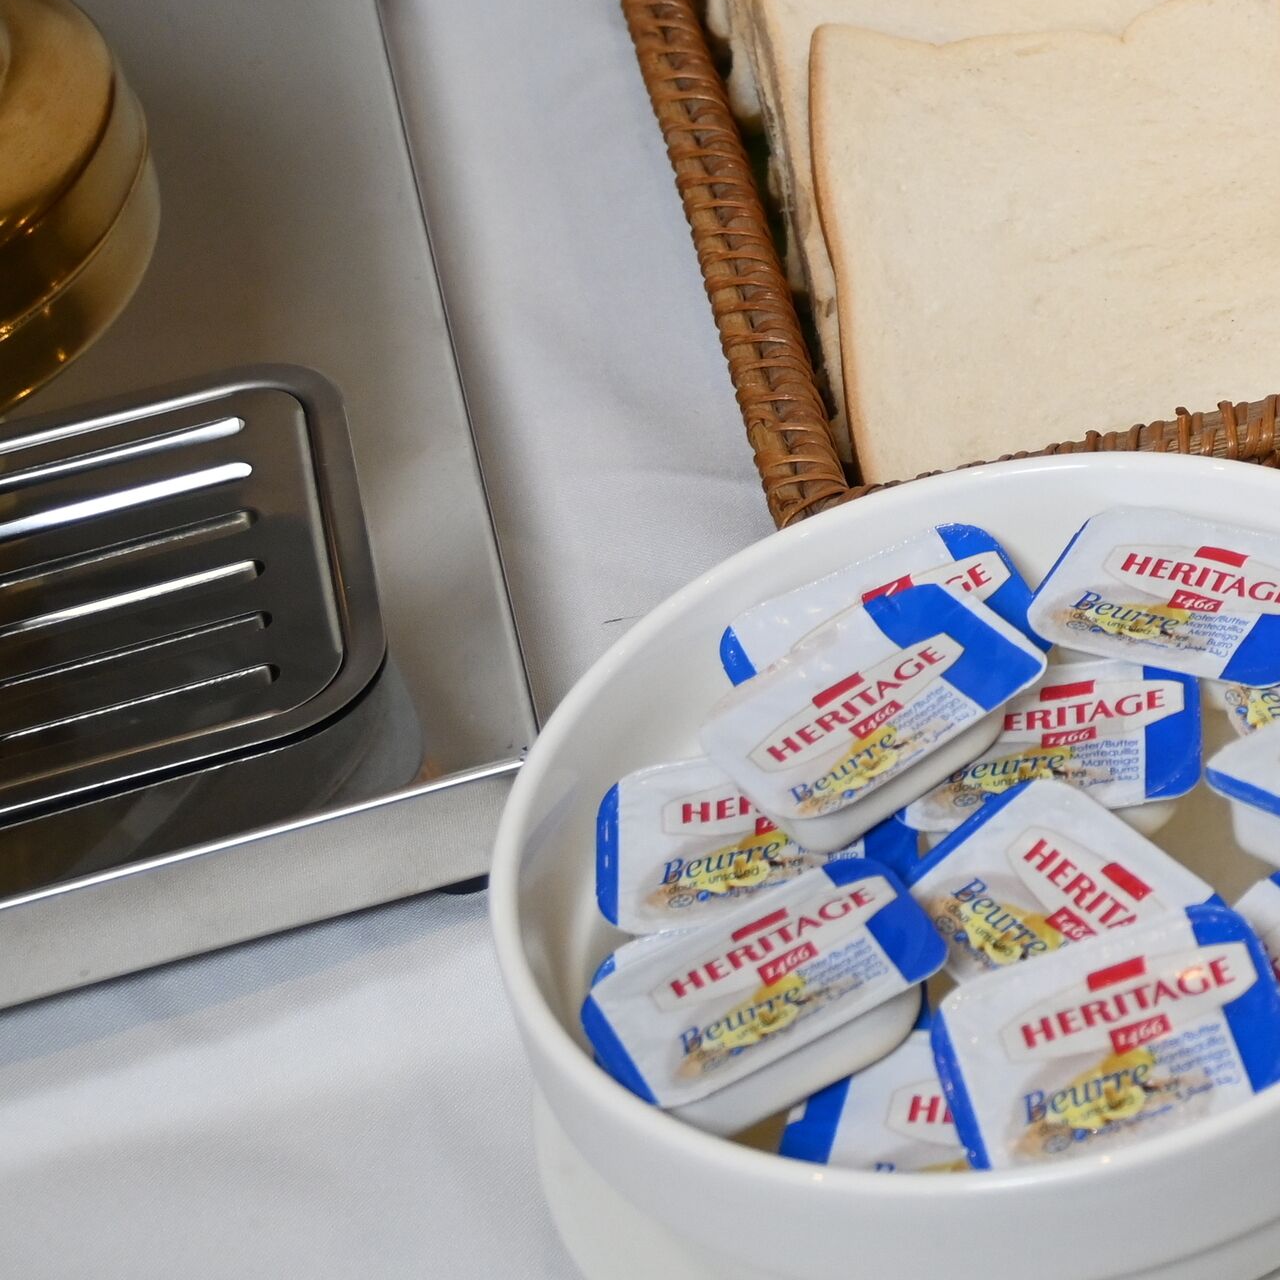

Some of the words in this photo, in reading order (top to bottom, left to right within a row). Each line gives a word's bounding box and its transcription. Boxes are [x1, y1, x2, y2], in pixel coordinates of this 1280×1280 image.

[1070, 590, 1180, 631] Beurre
[1176, 593, 1218, 611] 1466
[767, 646, 945, 763] HERITAGE
[857, 702, 897, 735] 1466
[1004, 689, 1166, 733] ERITAGE
[1048, 730, 1091, 747] 1466
[788, 732, 896, 805] Beurre
[659, 840, 780, 885] Beurre
[951, 877, 1047, 954] Beurre
[670, 888, 874, 999] HERITAGE
[680, 985, 802, 1056] Beurre
[1021, 956, 1235, 1049] HERITAGE
[1115, 1018, 1165, 1048] 1466
[1023, 1062, 1150, 1125] Beurre
